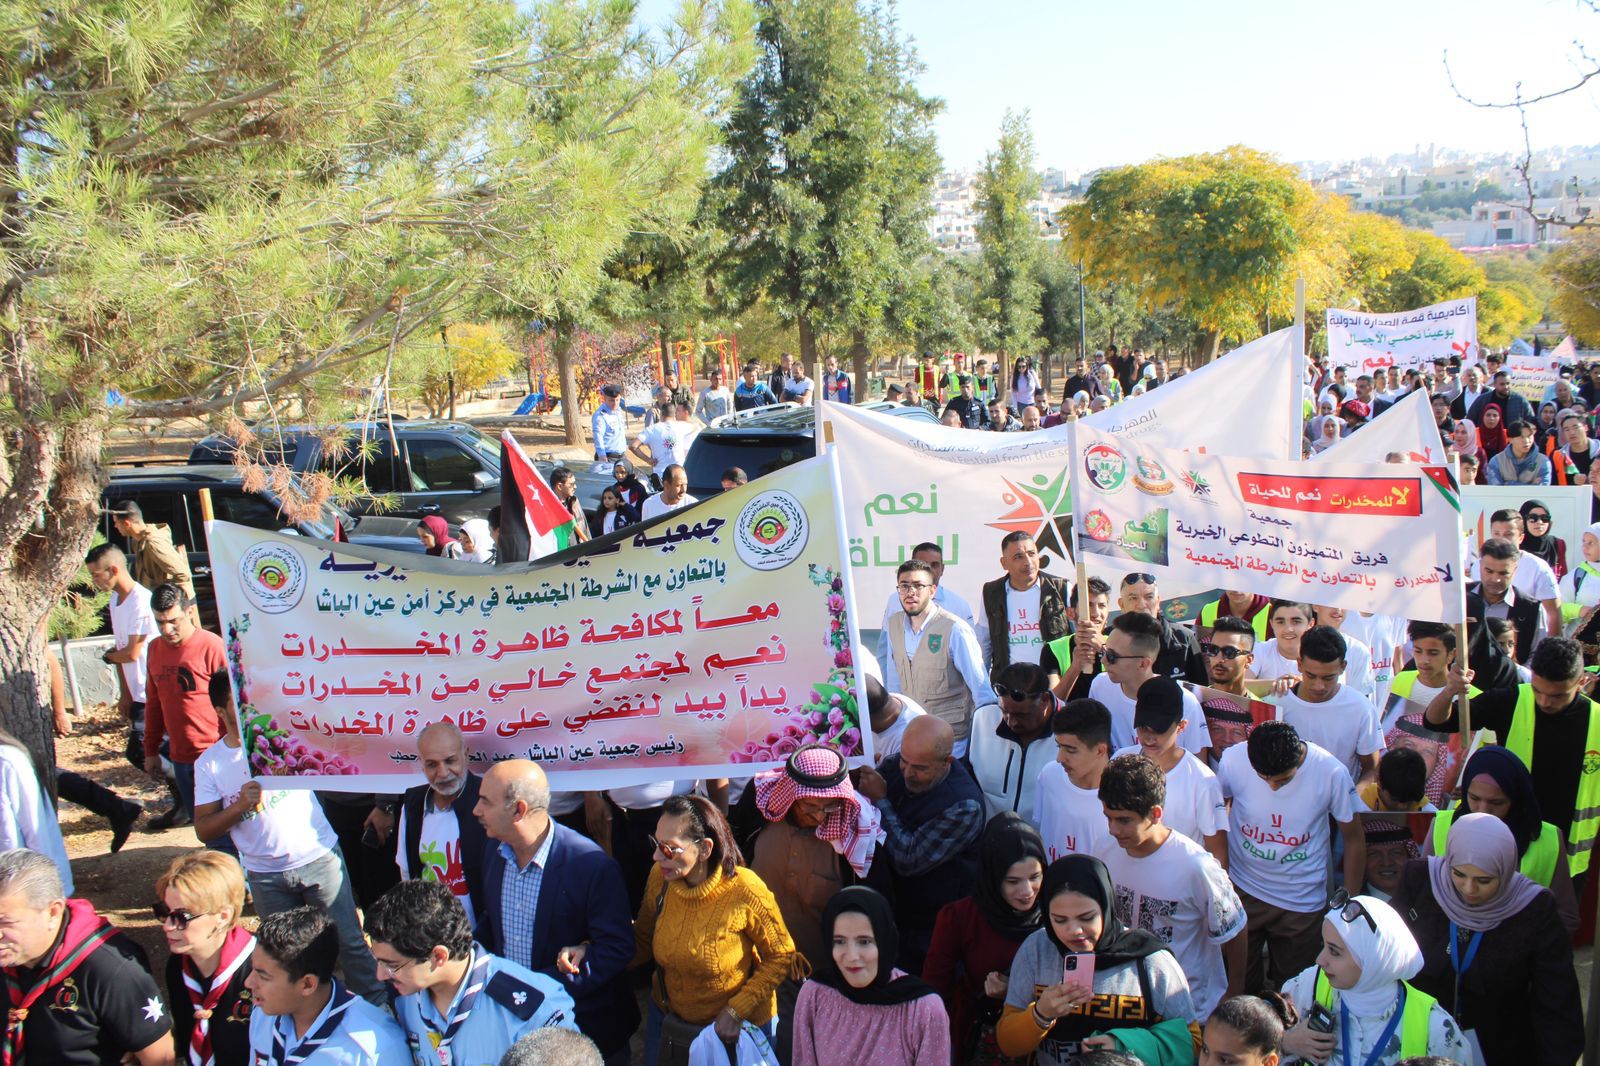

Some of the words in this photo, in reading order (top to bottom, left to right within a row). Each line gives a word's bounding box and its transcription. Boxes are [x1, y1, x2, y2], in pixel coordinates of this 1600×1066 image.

[1329, 314, 1361, 327] الدولية
[1362, 351, 1394, 373] نعم
[1452, 341, 1470, 360] لا
[1107, 409, 1158, 432] المهرجا
[1249, 483, 1291, 499] للحياة
[1295, 488, 1322, 504] نعم
[1330, 493, 1393, 509] للمخدرات
[1391, 486, 1410, 506] لا
[864, 483, 938, 527] نعم
[1123, 515, 1160, 537] نعم
[1176, 519, 1226, 540] الخيرية
[1248, 508, 1293, 530] جمعية
[1116, 537, 1148, 551] للحياة
[1229, 533, 1284, 549] التطوعي
[1288, 543, 1343, 561] المتميزون
[1185, 547, 1244, 571] المجتمعية
[1247, 555, 1299, 577] الشرطة
[1351, 550, 1389, 567] فريق
[580, 567, 638, 600] الشرطة
[643, 571, 662, 597] مع
[666, 557, 727, 591] بالتعاون
[1301, 567, 1318, 584] مع
[1321, 570, 1377, 593] بالتعاون
[1433, 563, 1453, 582] لا
[316, 587, 359, 617] الباشا
[364, 592, 396, 616] عين
[401, 587, 430, 615] أمن
[434, 589, 475, 615] مركز
[480, 586, 500, 617] في
[505, 581, 576, 611] المجتمعية
[1018, 608, 1026, 619] لا
[580, 607, 684, 644] لمكافحة
[280, 631, 462, 662] المخدرات
[472, 626, 570, 661] ظاهرة
[703, 633, 788, 677] نعم
[488, 661, 577, 703] خالي
[585, 650, 692, 695] لمجتمع
[281, 671, 423, 703] المخدرات
[431, 673, 481, 702] من
[563, 690, 662, 735] لنقضي
[674, 689, 727, 720] بيد
[290, 709, 395, 737] المخدرات
[496, 707, 552, 737] على
[569, 744, 594, 762] عين
[599, 740, 641, 758] جمعية
[645, 735, 685, 755] رئيس
[1271, 813, 1283, 828] لا
[1066, 835, 1076, 851] لا
[1241, 823, 1311, 847] للمخدرات
[1281, 847, 1308, 864] نعم
